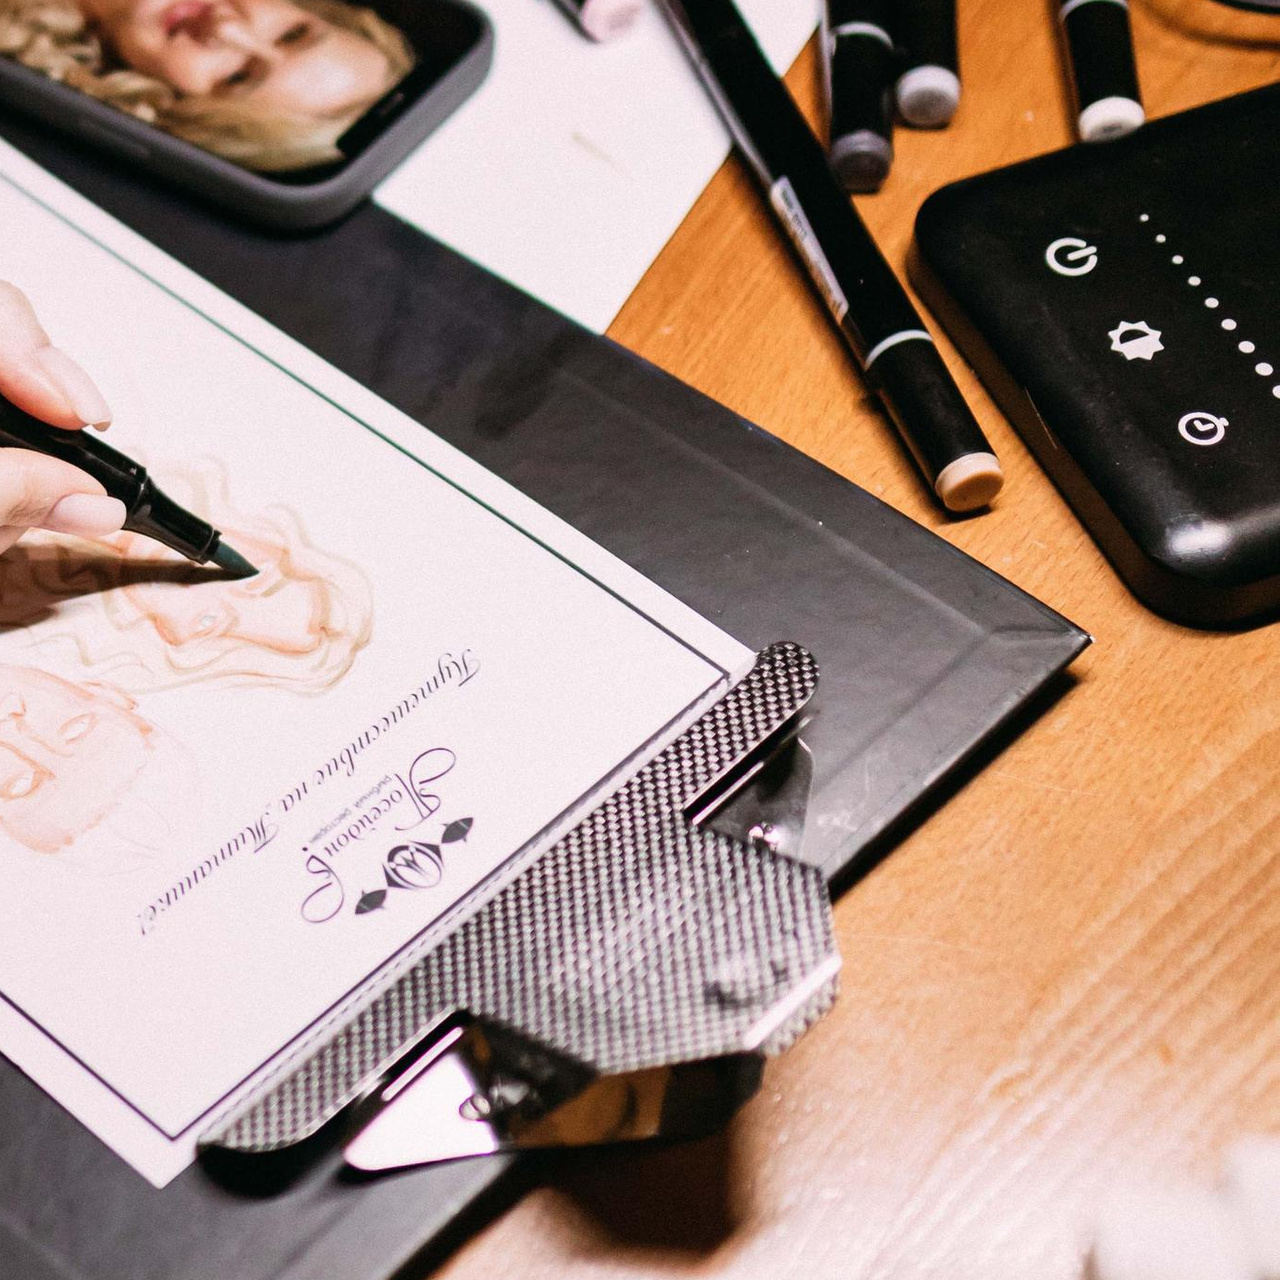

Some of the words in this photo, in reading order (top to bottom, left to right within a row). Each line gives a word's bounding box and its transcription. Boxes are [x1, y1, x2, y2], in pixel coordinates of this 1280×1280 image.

[317, 649, 481, 786] Путешествие
[283, 781, 310, 812] на
[324, 748, 457, 858] Посейдон
